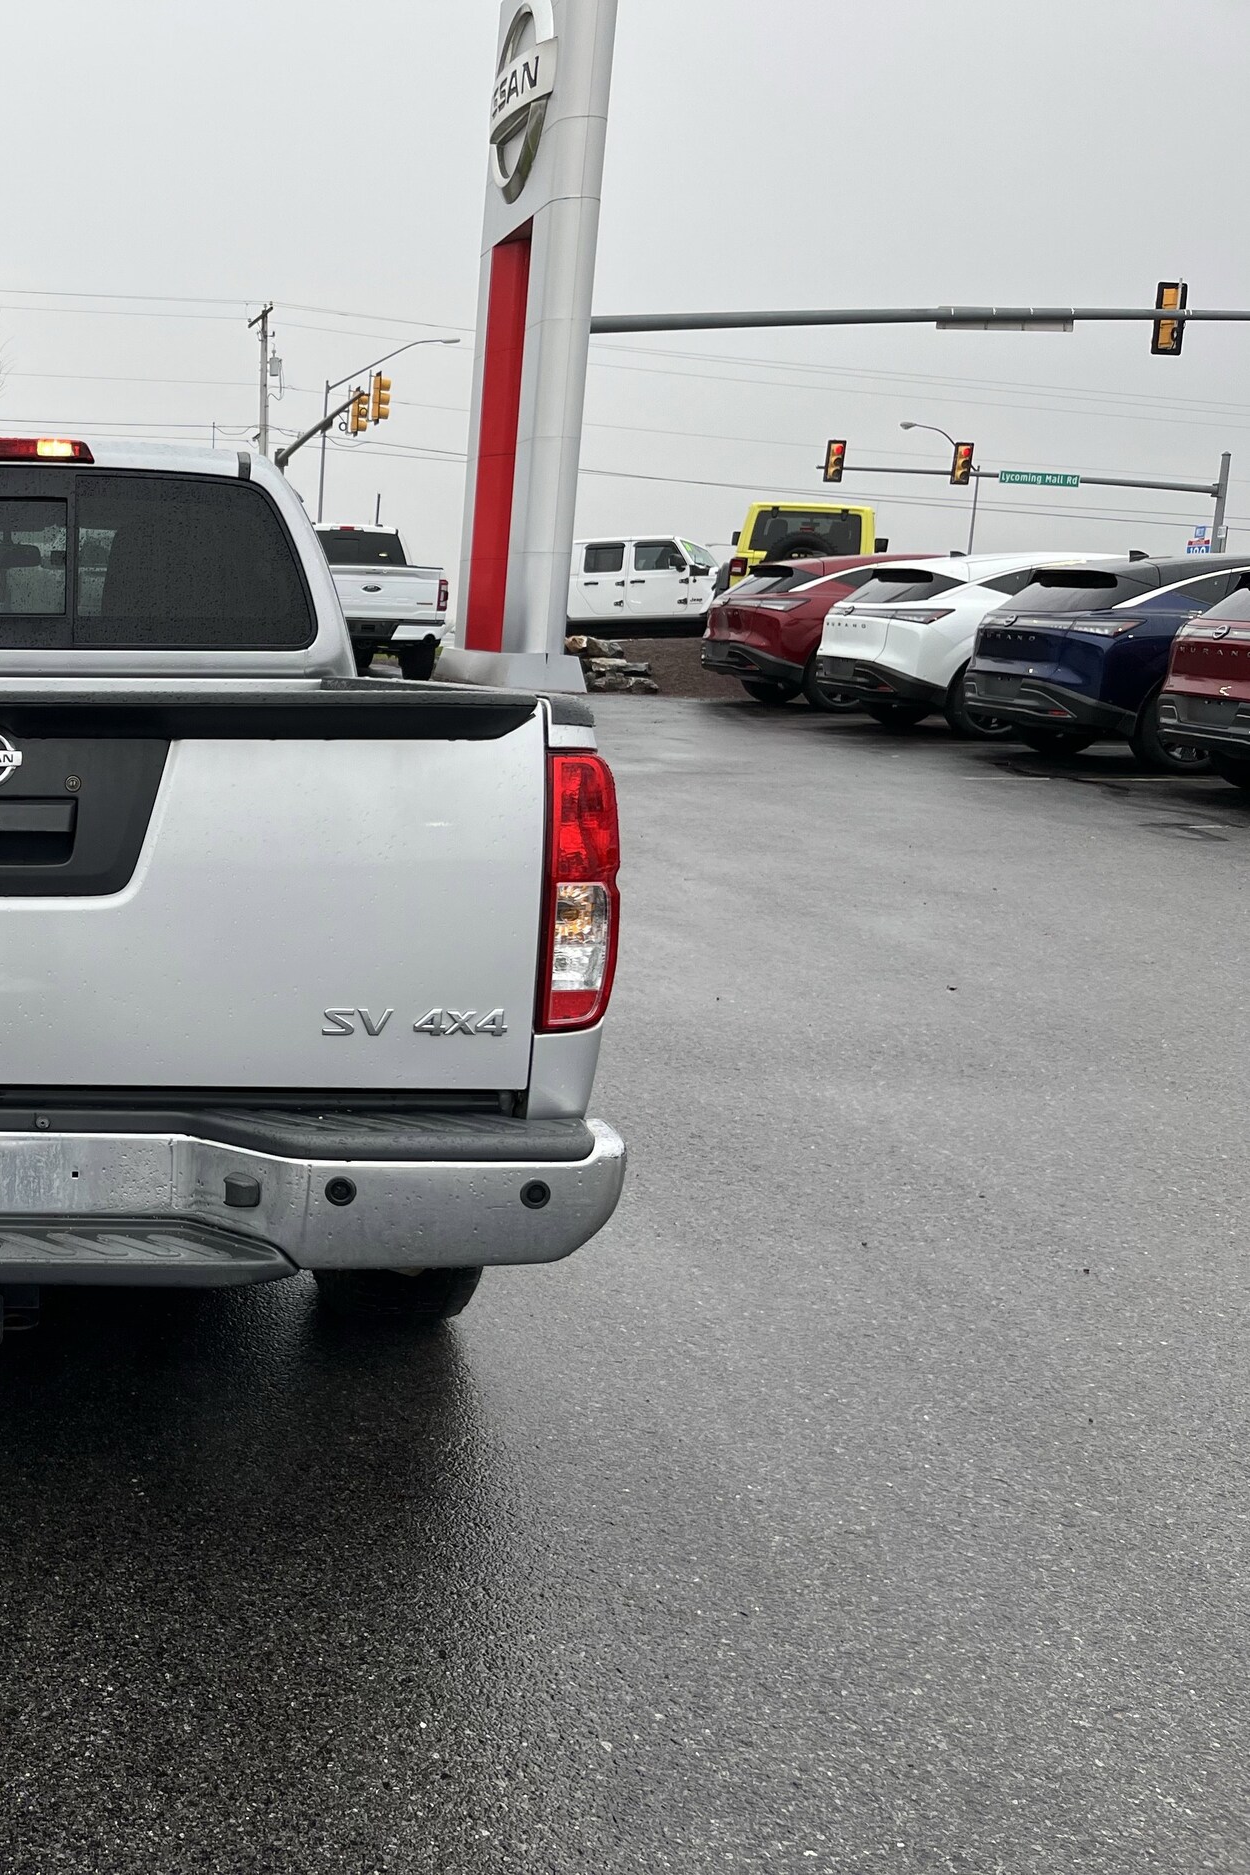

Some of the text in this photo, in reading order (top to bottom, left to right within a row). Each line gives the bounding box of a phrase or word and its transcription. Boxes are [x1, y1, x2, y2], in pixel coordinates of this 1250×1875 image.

[1001, 472, 1078, 485] Lycoming Mall Rd
[322, 1008, 395, 1036] SV
